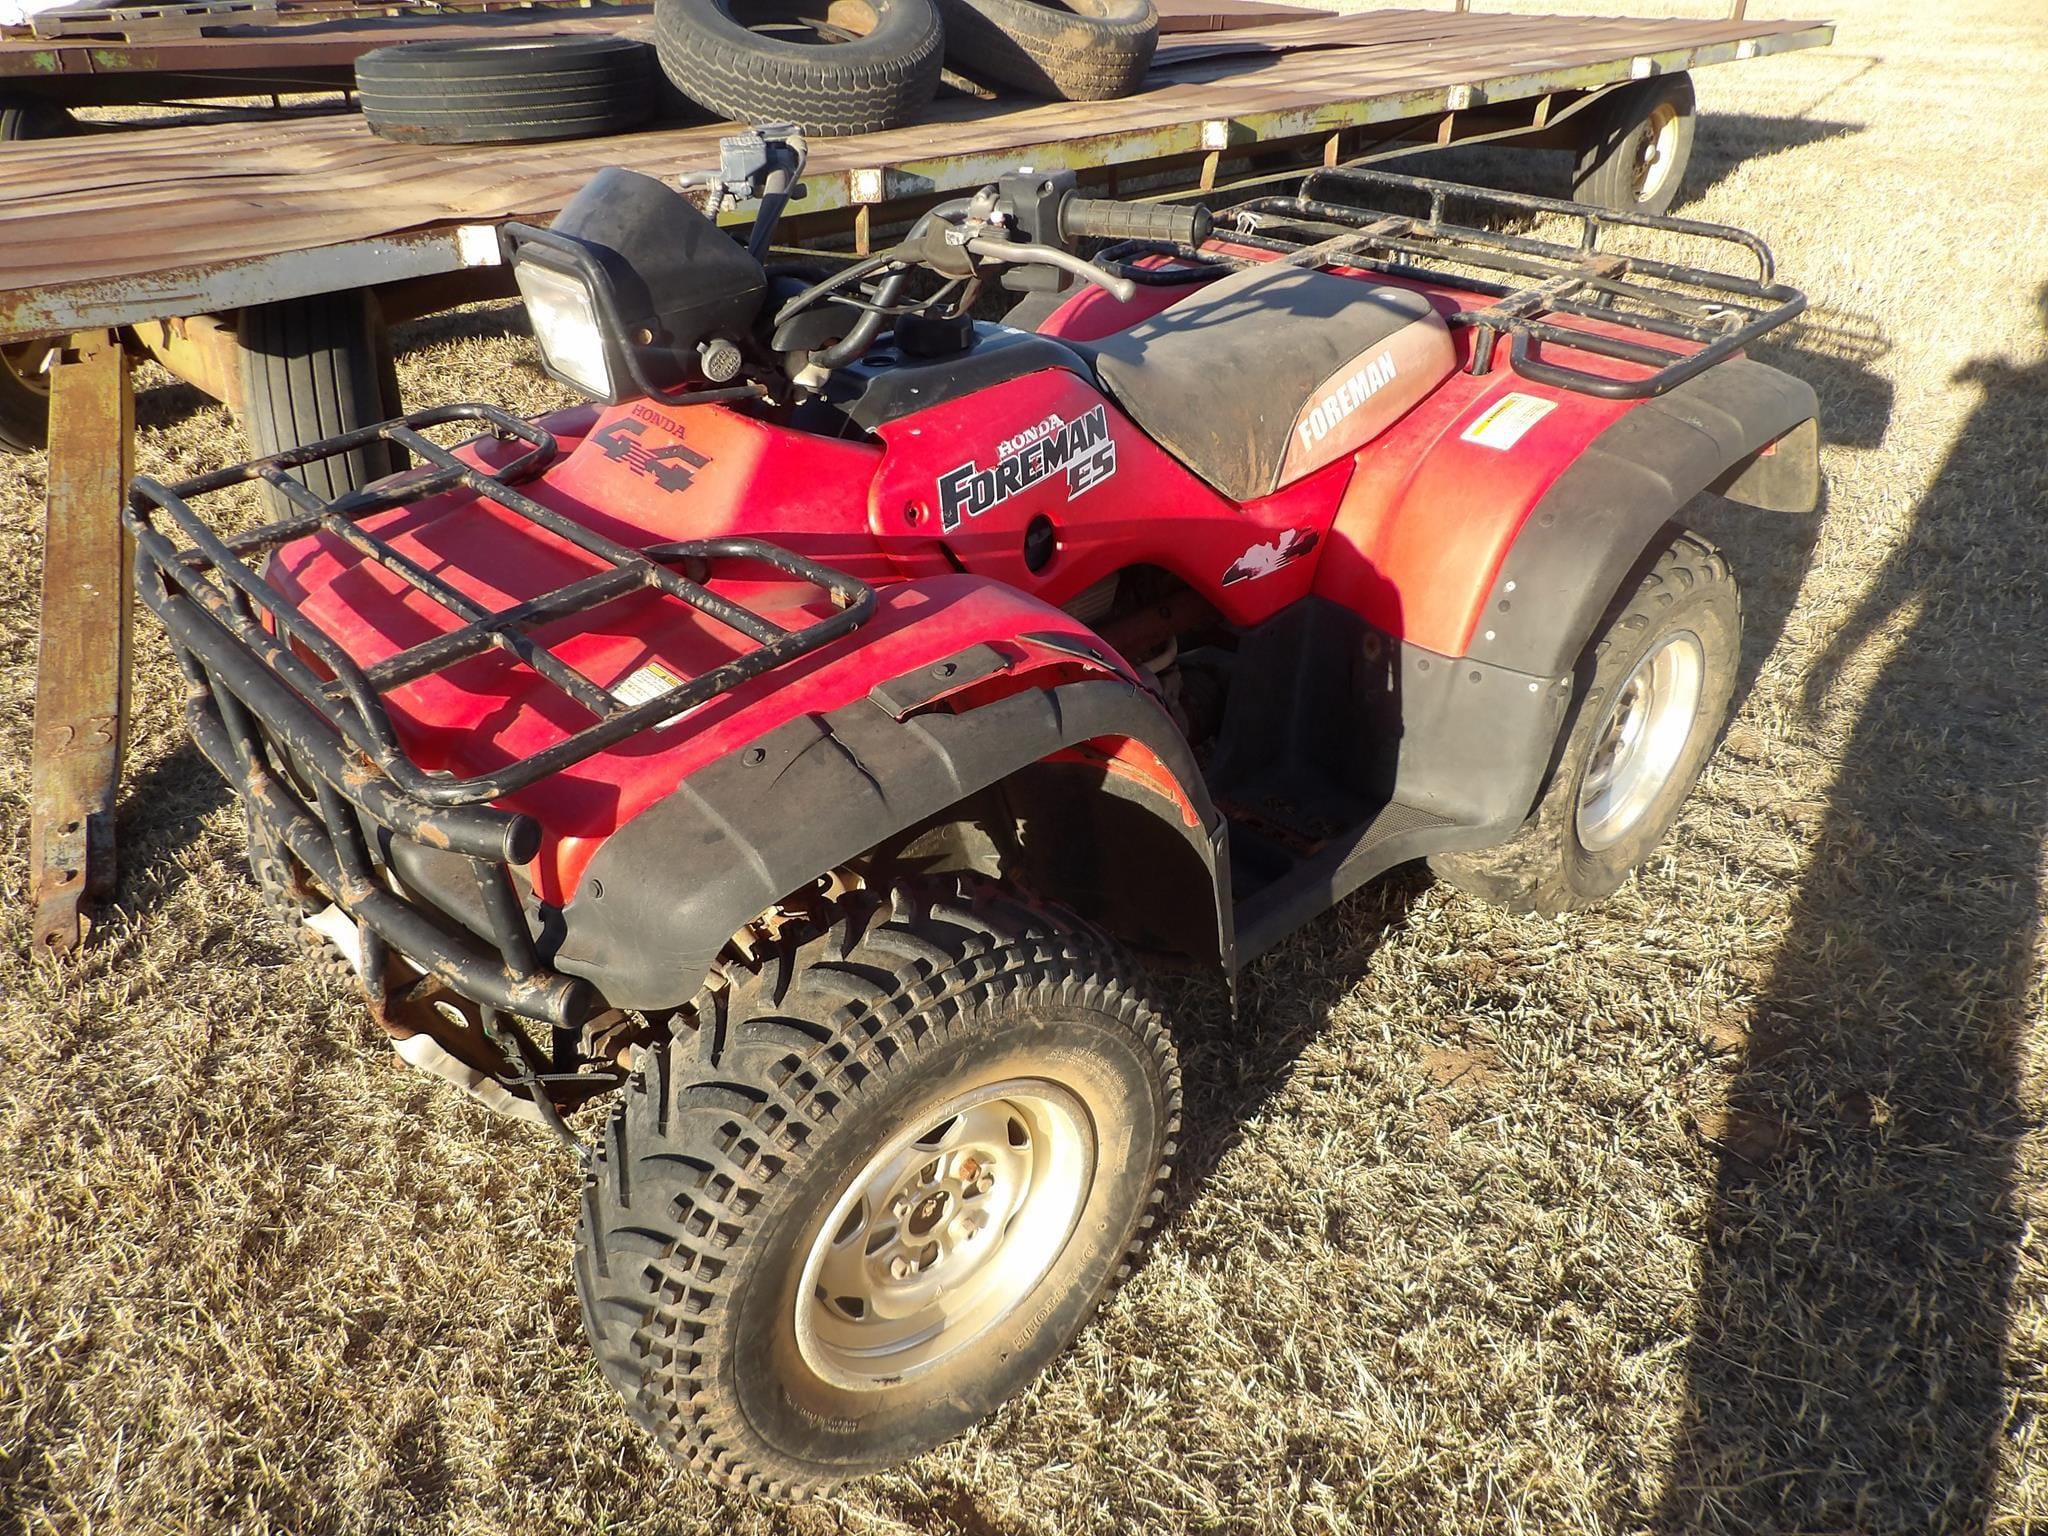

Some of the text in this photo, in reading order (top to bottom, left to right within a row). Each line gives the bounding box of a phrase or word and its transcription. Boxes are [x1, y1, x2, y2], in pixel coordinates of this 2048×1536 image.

[631, 404, 686, 440] HONDA
[1298, 350, 1397, 453] FOREMAN
[996, 413, 1065, 460] HONDA
[937, 404, 1108, 534] FOREMAN
[1067, 440, 1117, 502] ES
